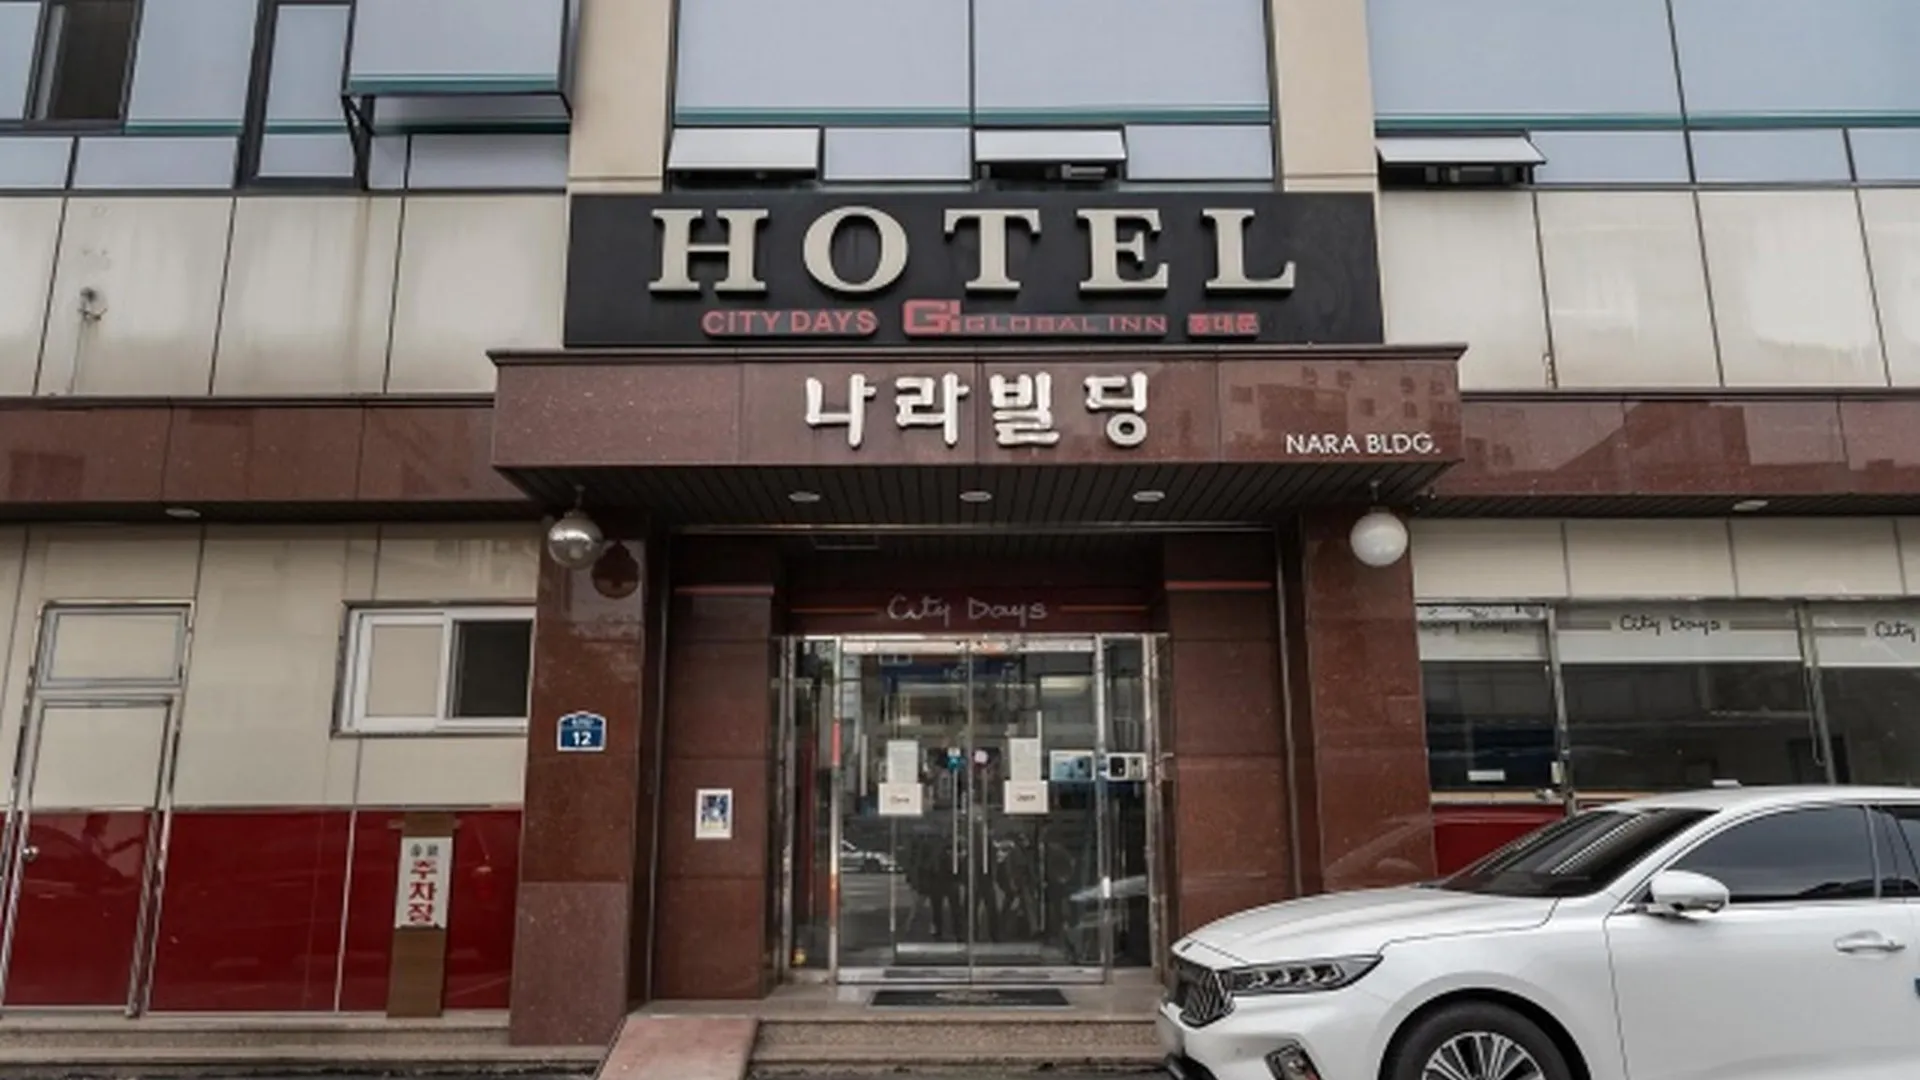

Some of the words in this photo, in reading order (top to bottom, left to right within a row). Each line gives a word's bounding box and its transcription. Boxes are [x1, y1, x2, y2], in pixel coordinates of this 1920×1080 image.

[648, 205, 1297, 293] HOTEL
[702, 310, 782, 335] CITY
[790, 310, 879, 335] DAYS
[965, 315, 1098, 333] GLOBAL
[1108, 315, 1168, 333] INN
[804, 372, 1148, 448] 나라빌딩
[1285, 433, 1361, 455] NARA
[1365, 432, 1442, 455] BLDG.
[887, 594, 950, 628] City
[966, 596, 1048, 628] Days
[1619, 614, 1661, 636] City
[1874, 620, 1916, 643] City
[572, 731, 592, 746] 12
[407, 860, 438, 922] 주차장
